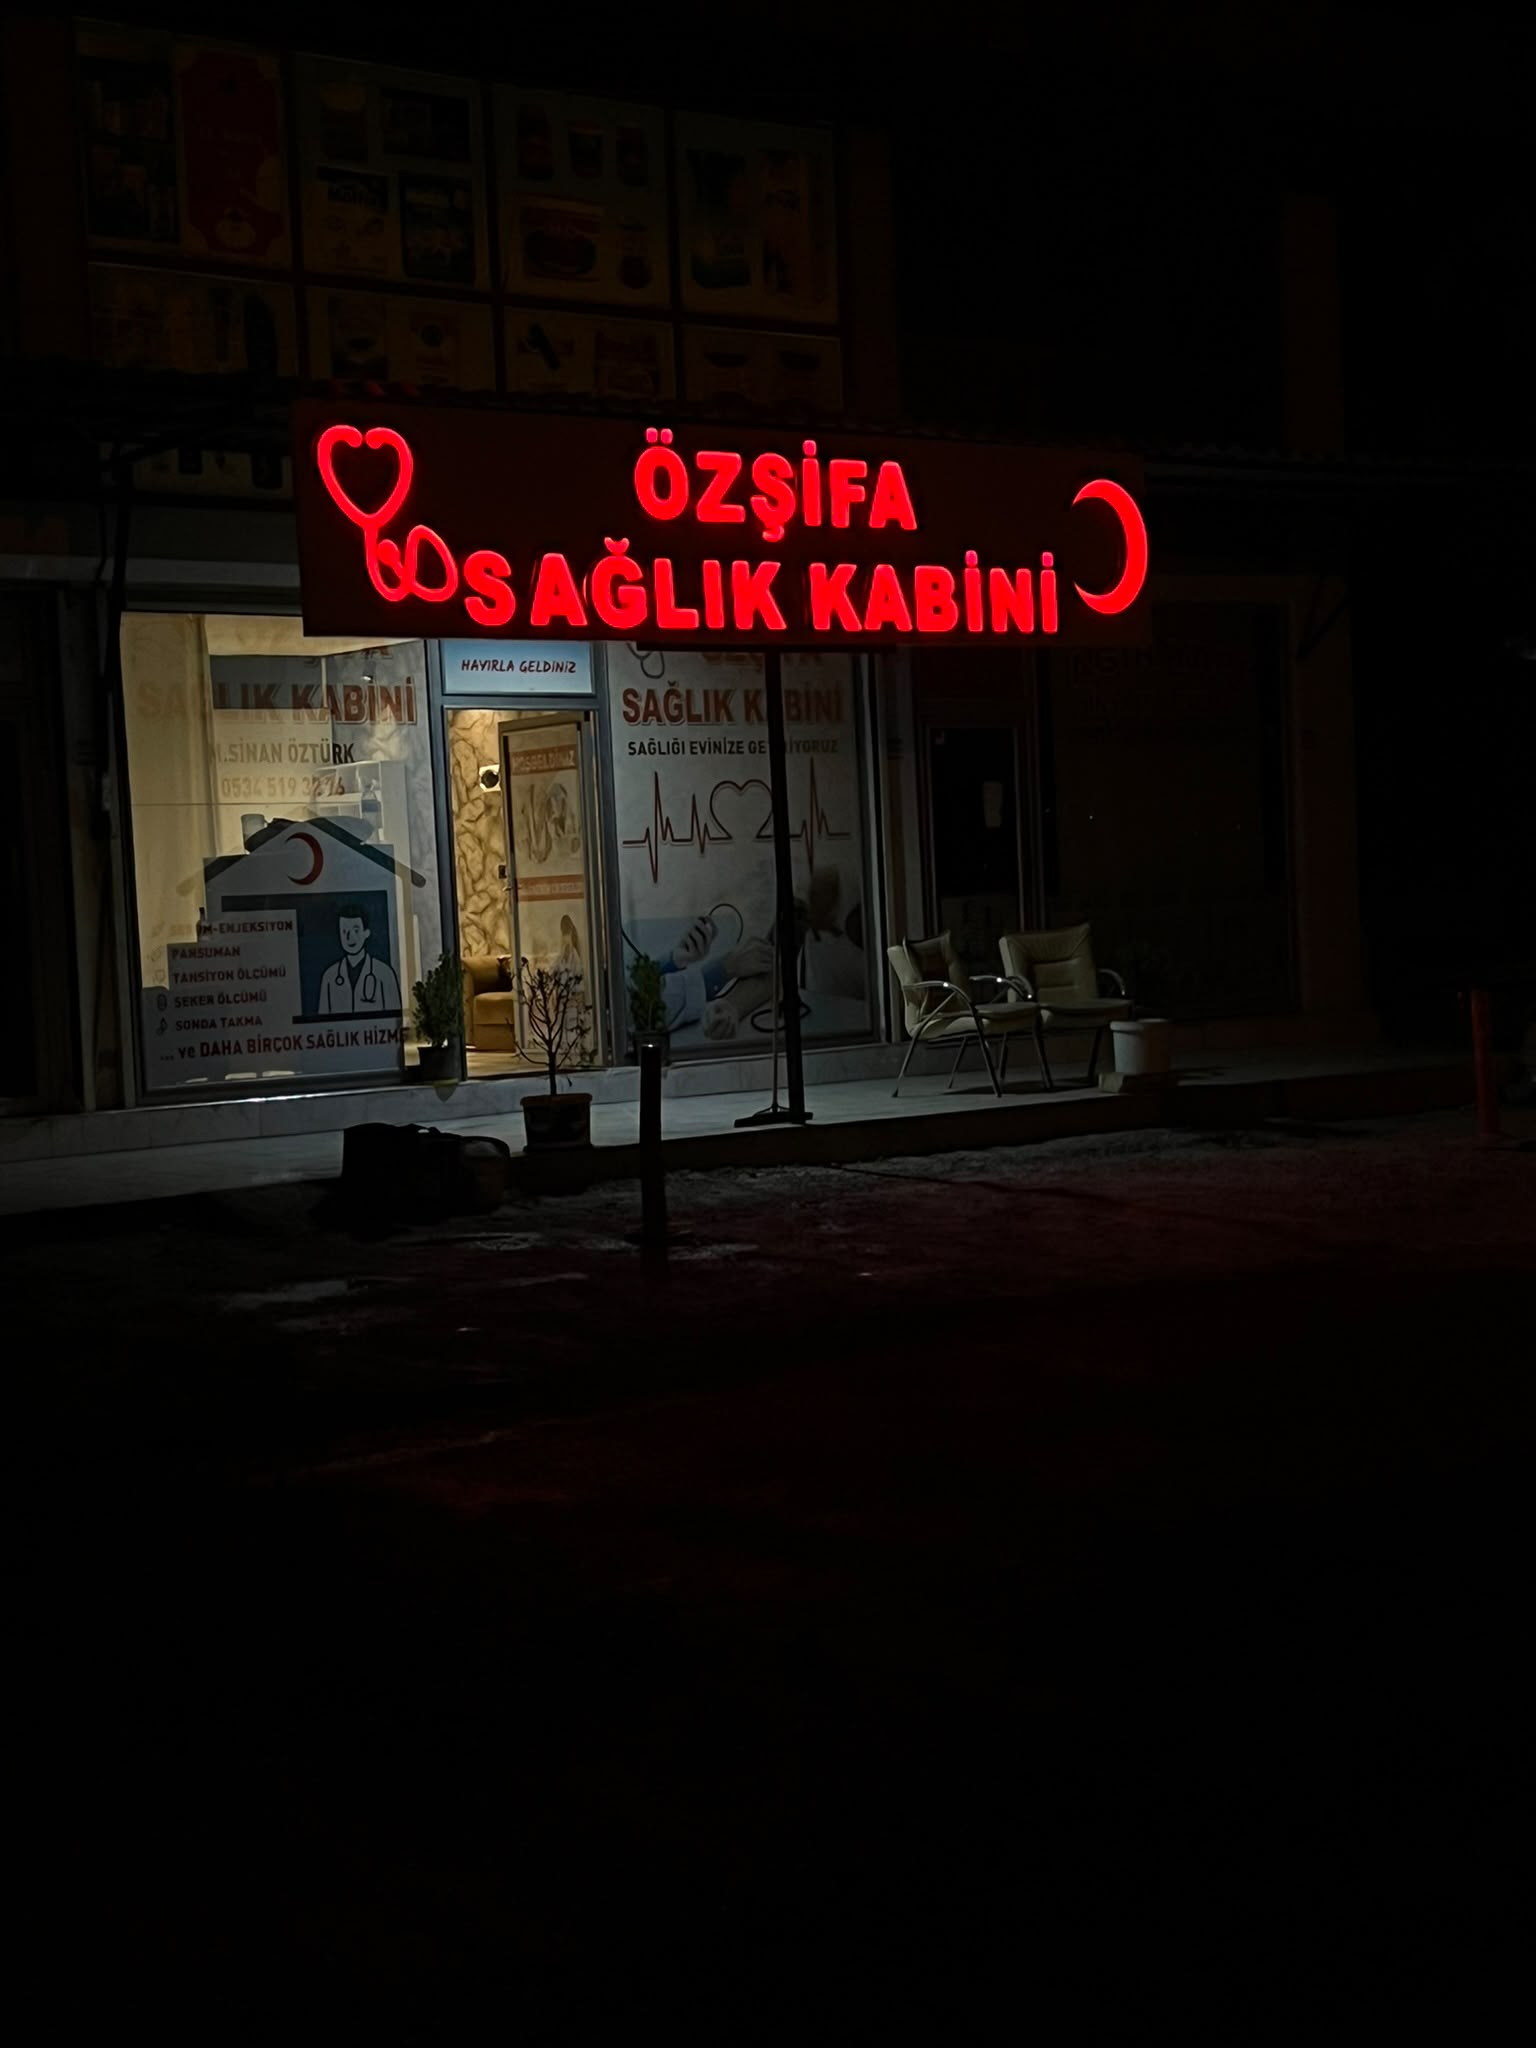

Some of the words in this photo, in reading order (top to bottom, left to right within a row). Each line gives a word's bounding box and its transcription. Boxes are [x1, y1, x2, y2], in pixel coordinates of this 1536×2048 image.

[634, 427, 918, 542] ÖZŞİFA
[463, 536, 787, 630] SAĞLIK
[810, 549, 1059, 635] KABİNİ
[461, 659, 514, 673] HAYIRLA
[519, 660, 577, 674] GELDİNİZ
[290, 676, 417, 725] KABİNİ
[622, 680, 738, 726] SAĞLIK
[743, 683, 842, 725] KBİNİ
[288, 736, 355, 764] ÖZTÜRK
[628, 738, 686, 756] SAĞLIĞI
[689, 737, 745, 755] EVİNİZE
[266, 777, 297, 797] 519
[173, 969, 233, 984] TANSİYON
[175, 1018, 217, 1032] SONDA
[220, 1015, 263, 1029] TAKMA
[200, 1039, 243, 1058] DAHA
[246, 1034, 303, 1054] BİRÇOK
[306, 1029, 360, 1048] SAĞLIK
